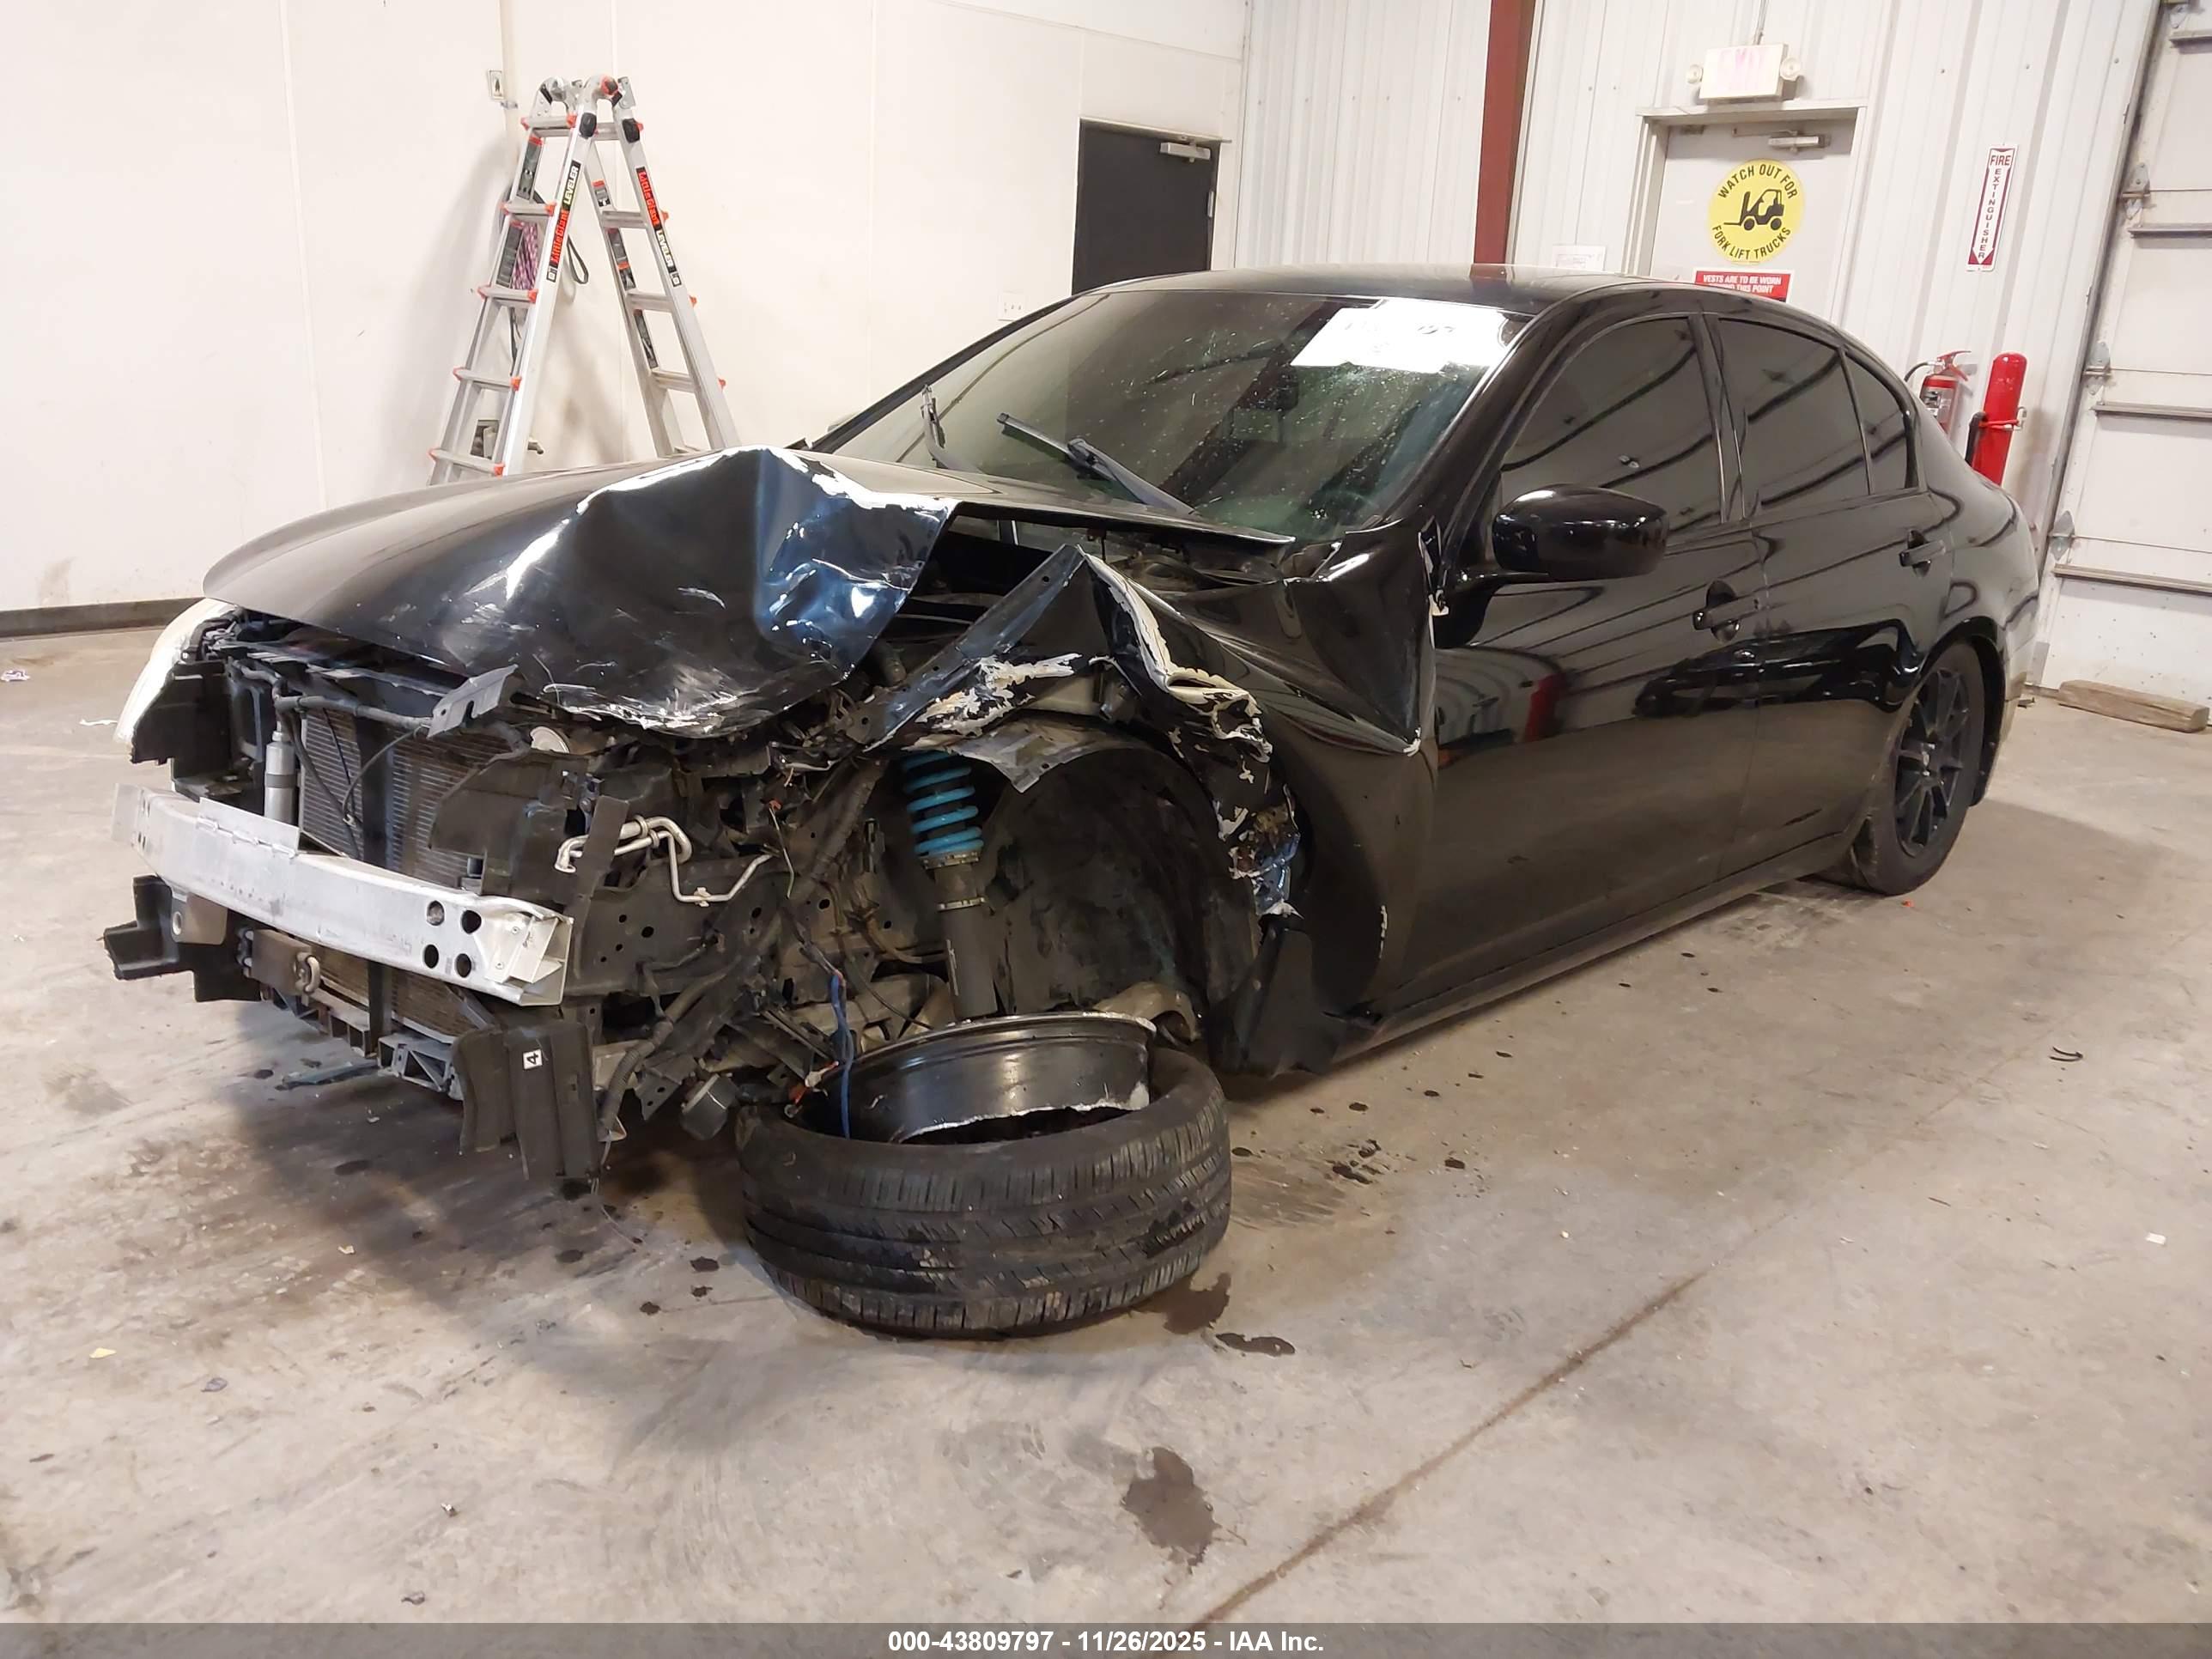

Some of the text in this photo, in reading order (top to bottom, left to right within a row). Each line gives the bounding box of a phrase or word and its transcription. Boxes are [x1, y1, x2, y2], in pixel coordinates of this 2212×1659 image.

[1990, 155, 2012, 166] FIRE
[563, 165, 579, 205] LEVELER
[1718, 164, 1798, 199] WATCH OUT FOR
[1978, 168, 2002, 258] EXTINGUISHER
[656, 229, 675, 267] LEVELER
[1712, 224, 1791, 259] FORK LIFT TRUCKS
[1703, 275, 1724, 283] VESTS
[1724, 275, 1738, 284] ARE
[1759, 276, 1782, 285] WORN
[1752, 285, 1774, 294] POINT
[526, 1053, 538, 1065] 4
